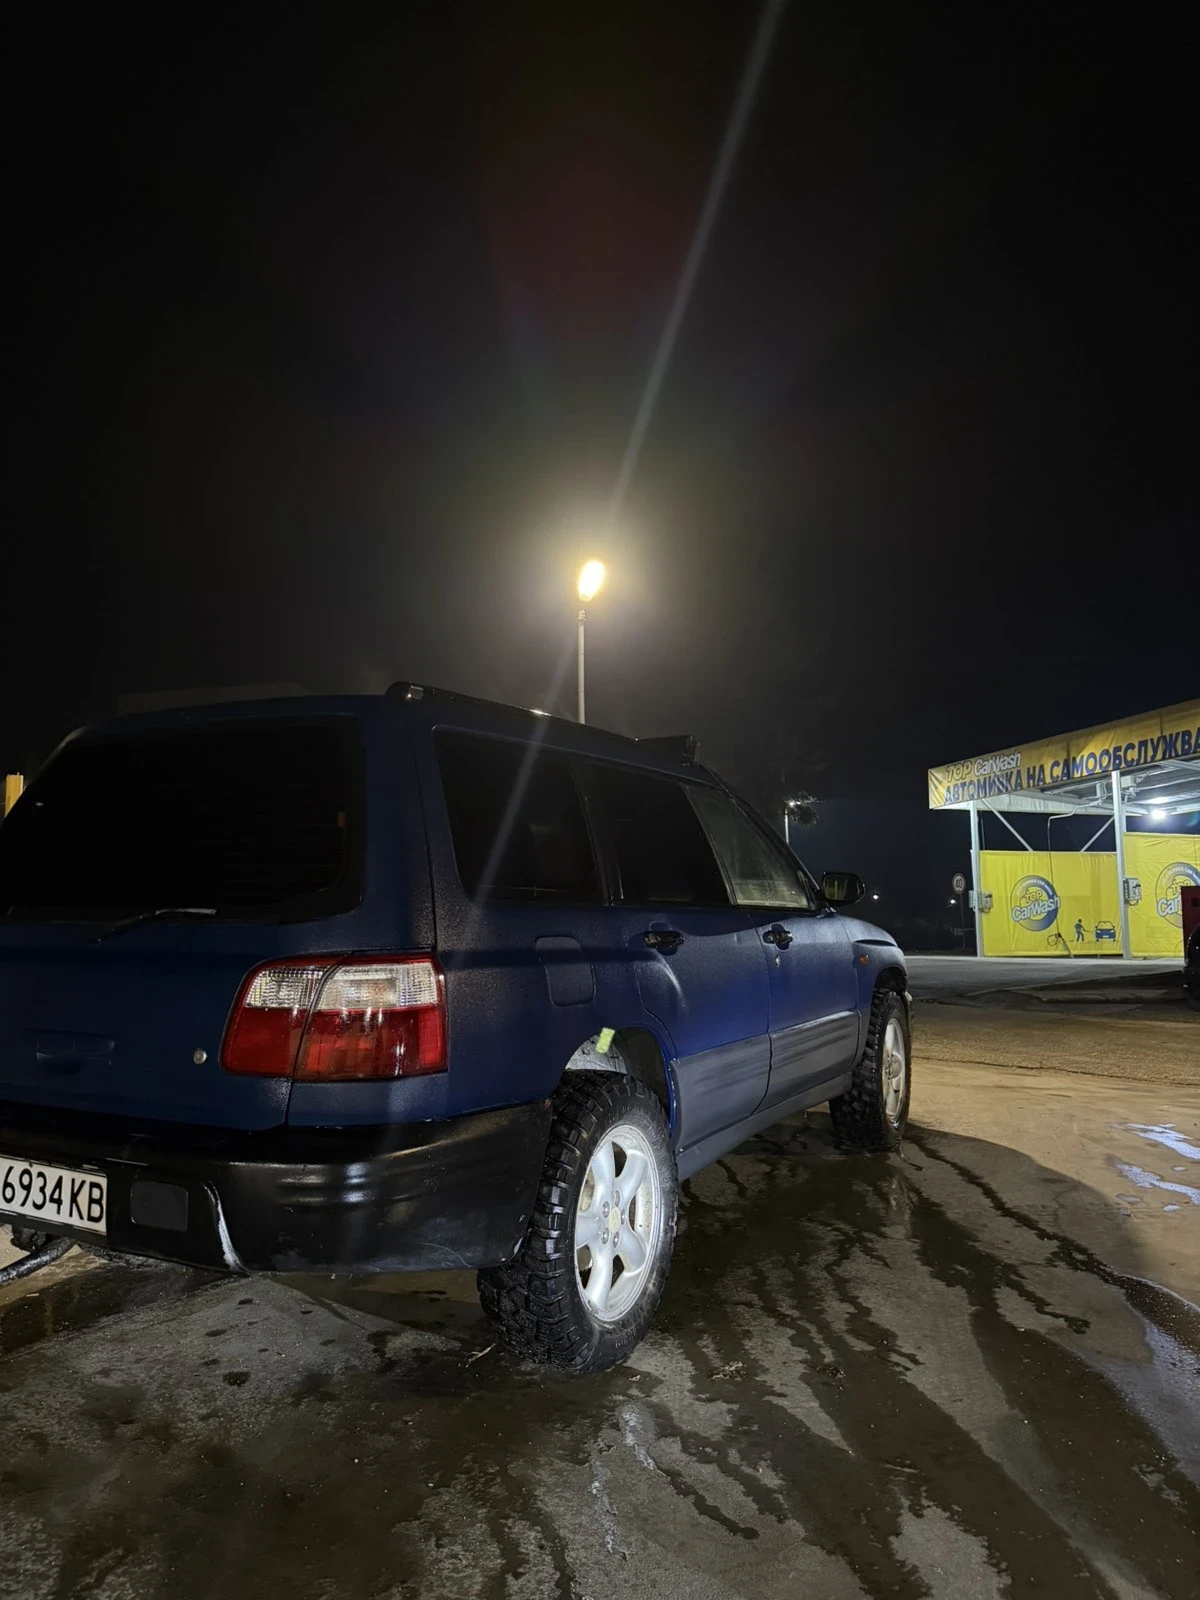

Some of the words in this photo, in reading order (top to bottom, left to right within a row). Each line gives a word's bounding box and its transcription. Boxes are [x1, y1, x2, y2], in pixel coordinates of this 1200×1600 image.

[945, 760, 972, 782] TOP
[973, 750, 1022, 776] CarWash
[1026, 764, 1047, 788] НА
[1011, 895, 1062, 922] CarWash
[1025, 889, 1043, 903] TOP
